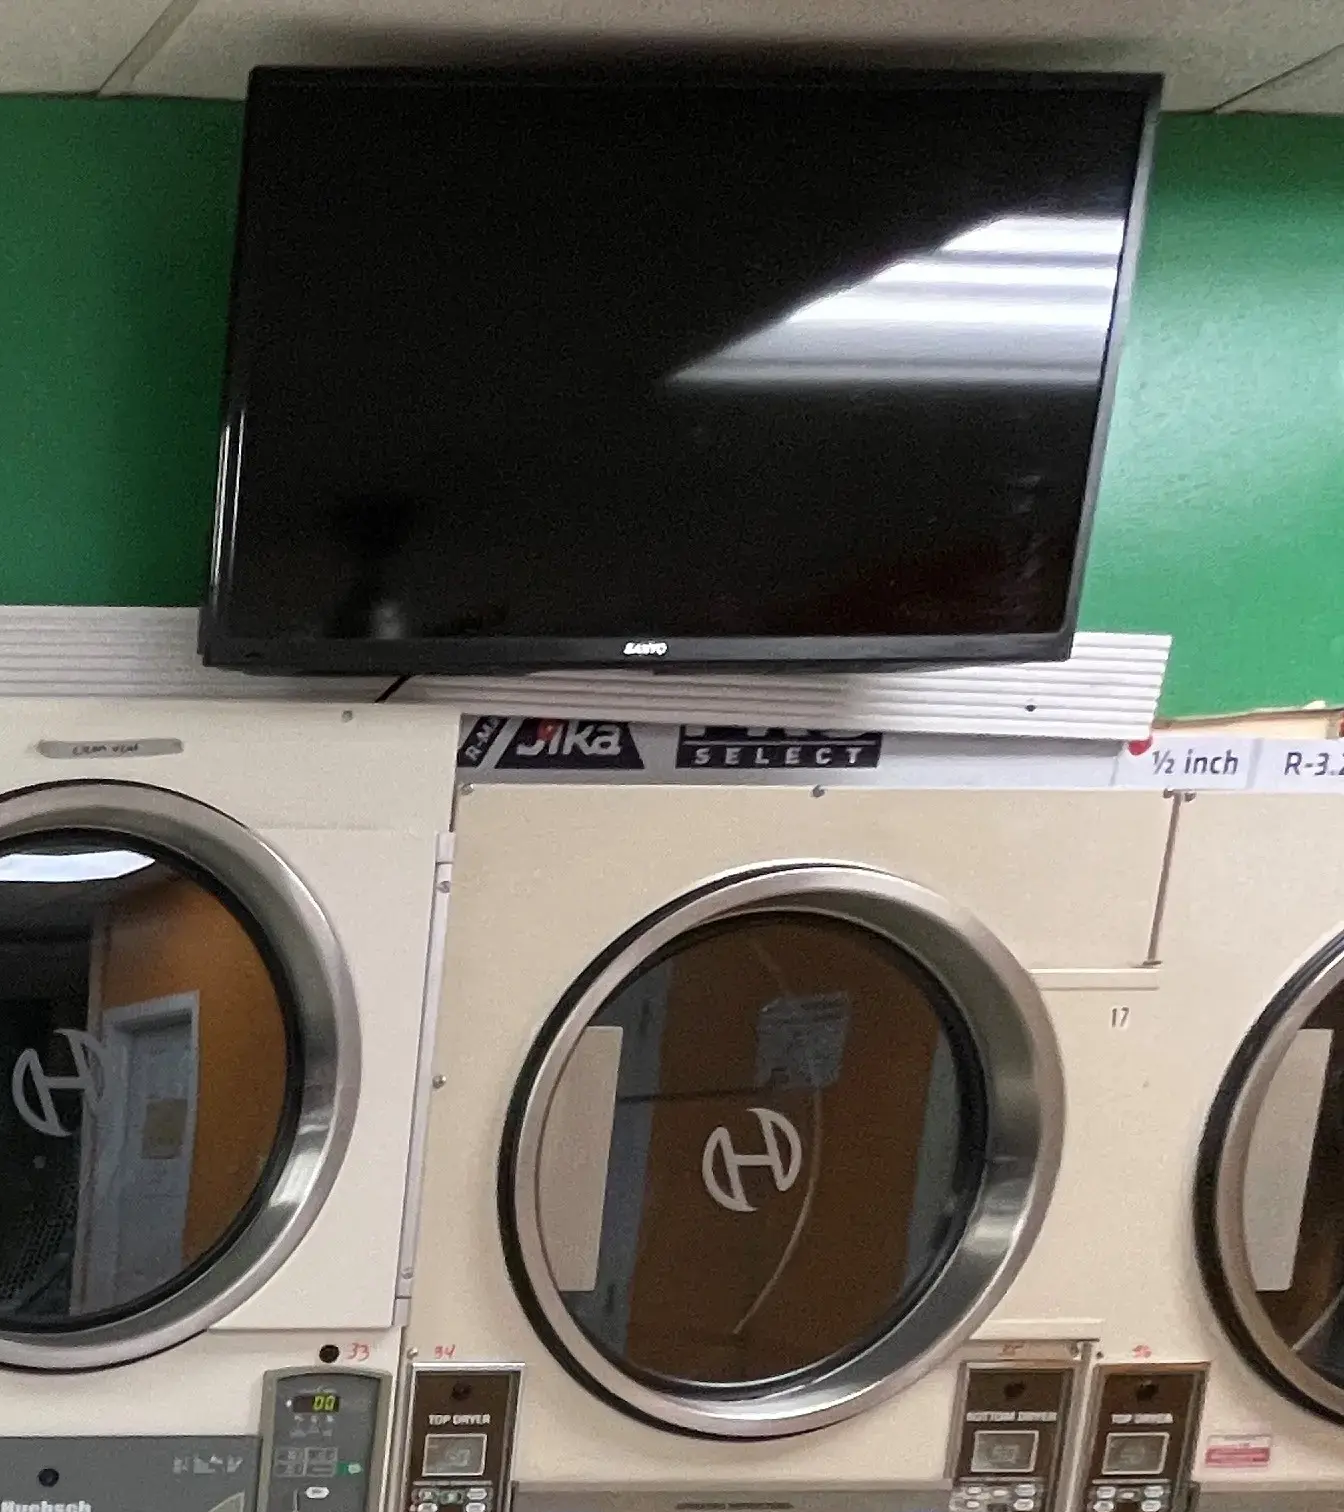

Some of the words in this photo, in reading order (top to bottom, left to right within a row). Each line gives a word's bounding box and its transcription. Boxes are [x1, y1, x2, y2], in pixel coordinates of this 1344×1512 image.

[694, 748, 863, 765] SELECT
[1184, 749, 1238, 775] inch
[1112, 1007, 1130, 1028] 17
[346, 1342, 370, 1361] 33
